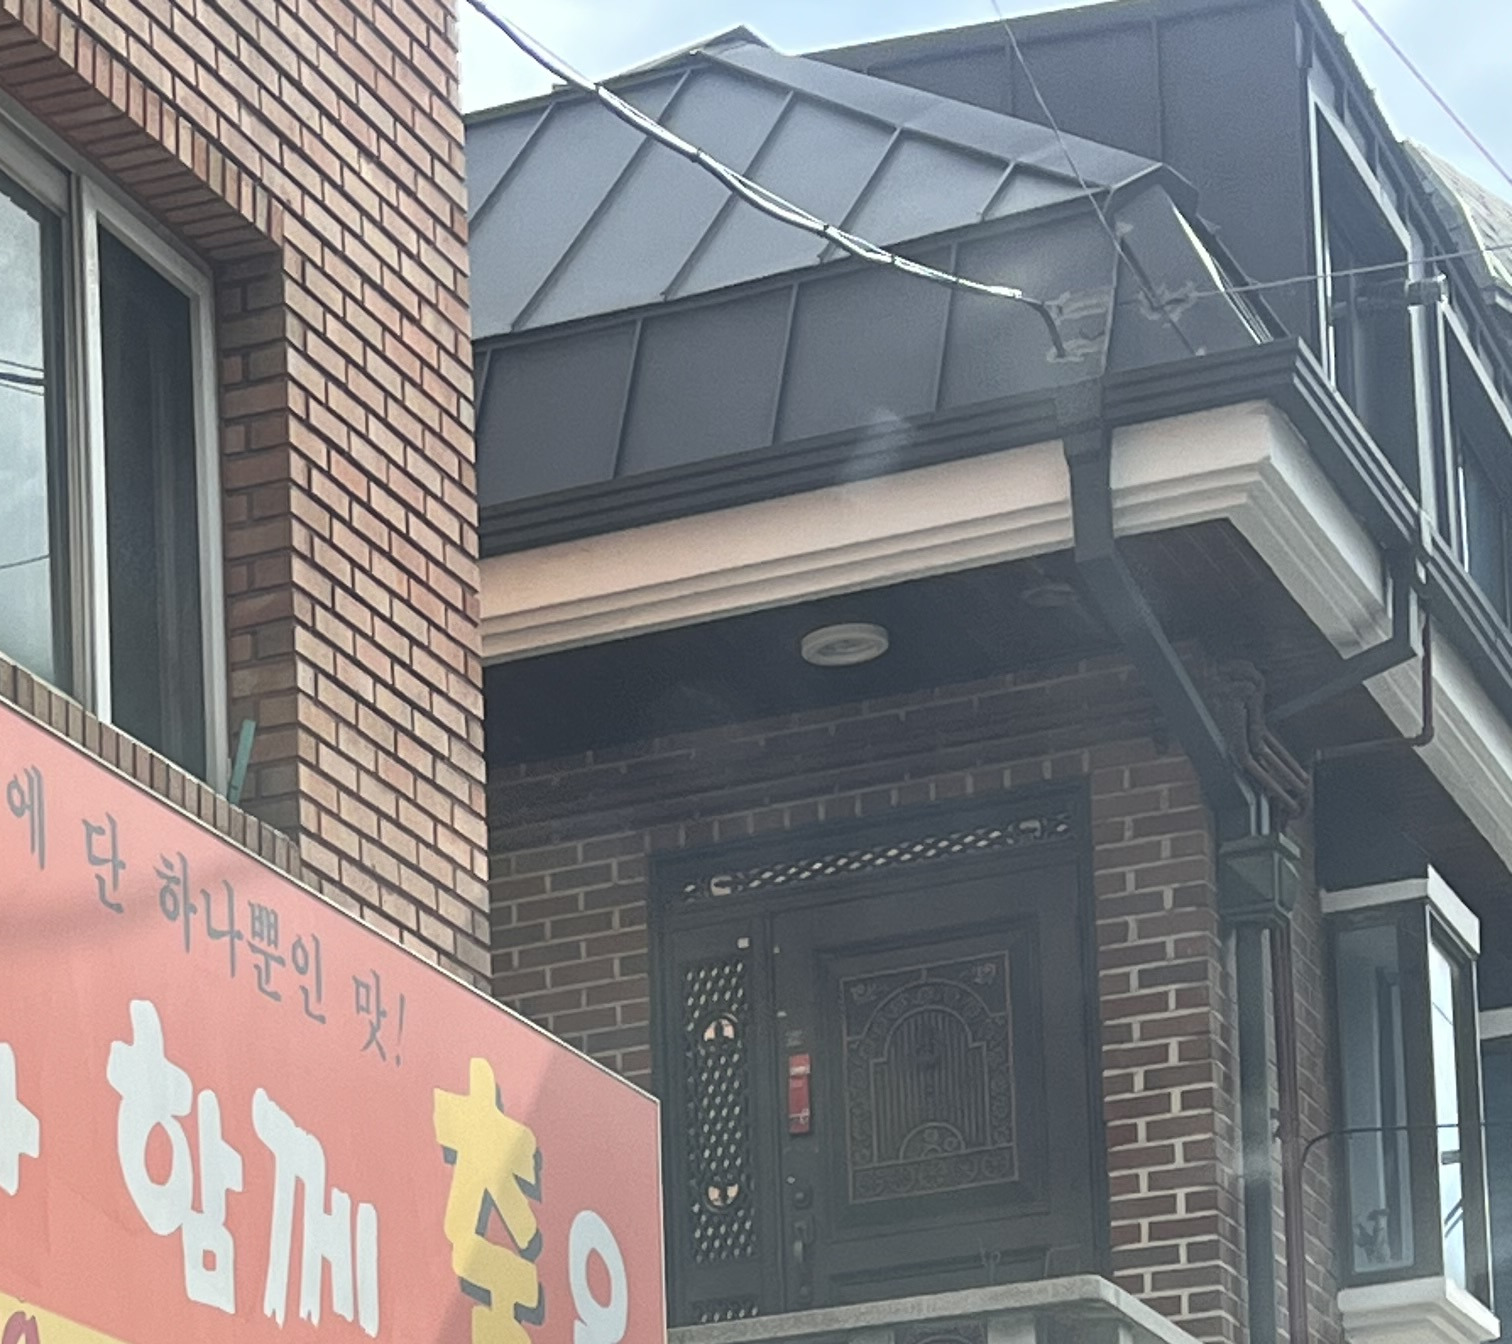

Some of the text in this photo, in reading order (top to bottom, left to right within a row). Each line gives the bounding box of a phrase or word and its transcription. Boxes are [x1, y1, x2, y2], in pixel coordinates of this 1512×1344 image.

[81, 812, 127, 915] 단
[153, 851, 327, 1025] 하나뿐인
[352, 969, 407, 1069] 맛!
[104, 999, 380, 1339] 함께
